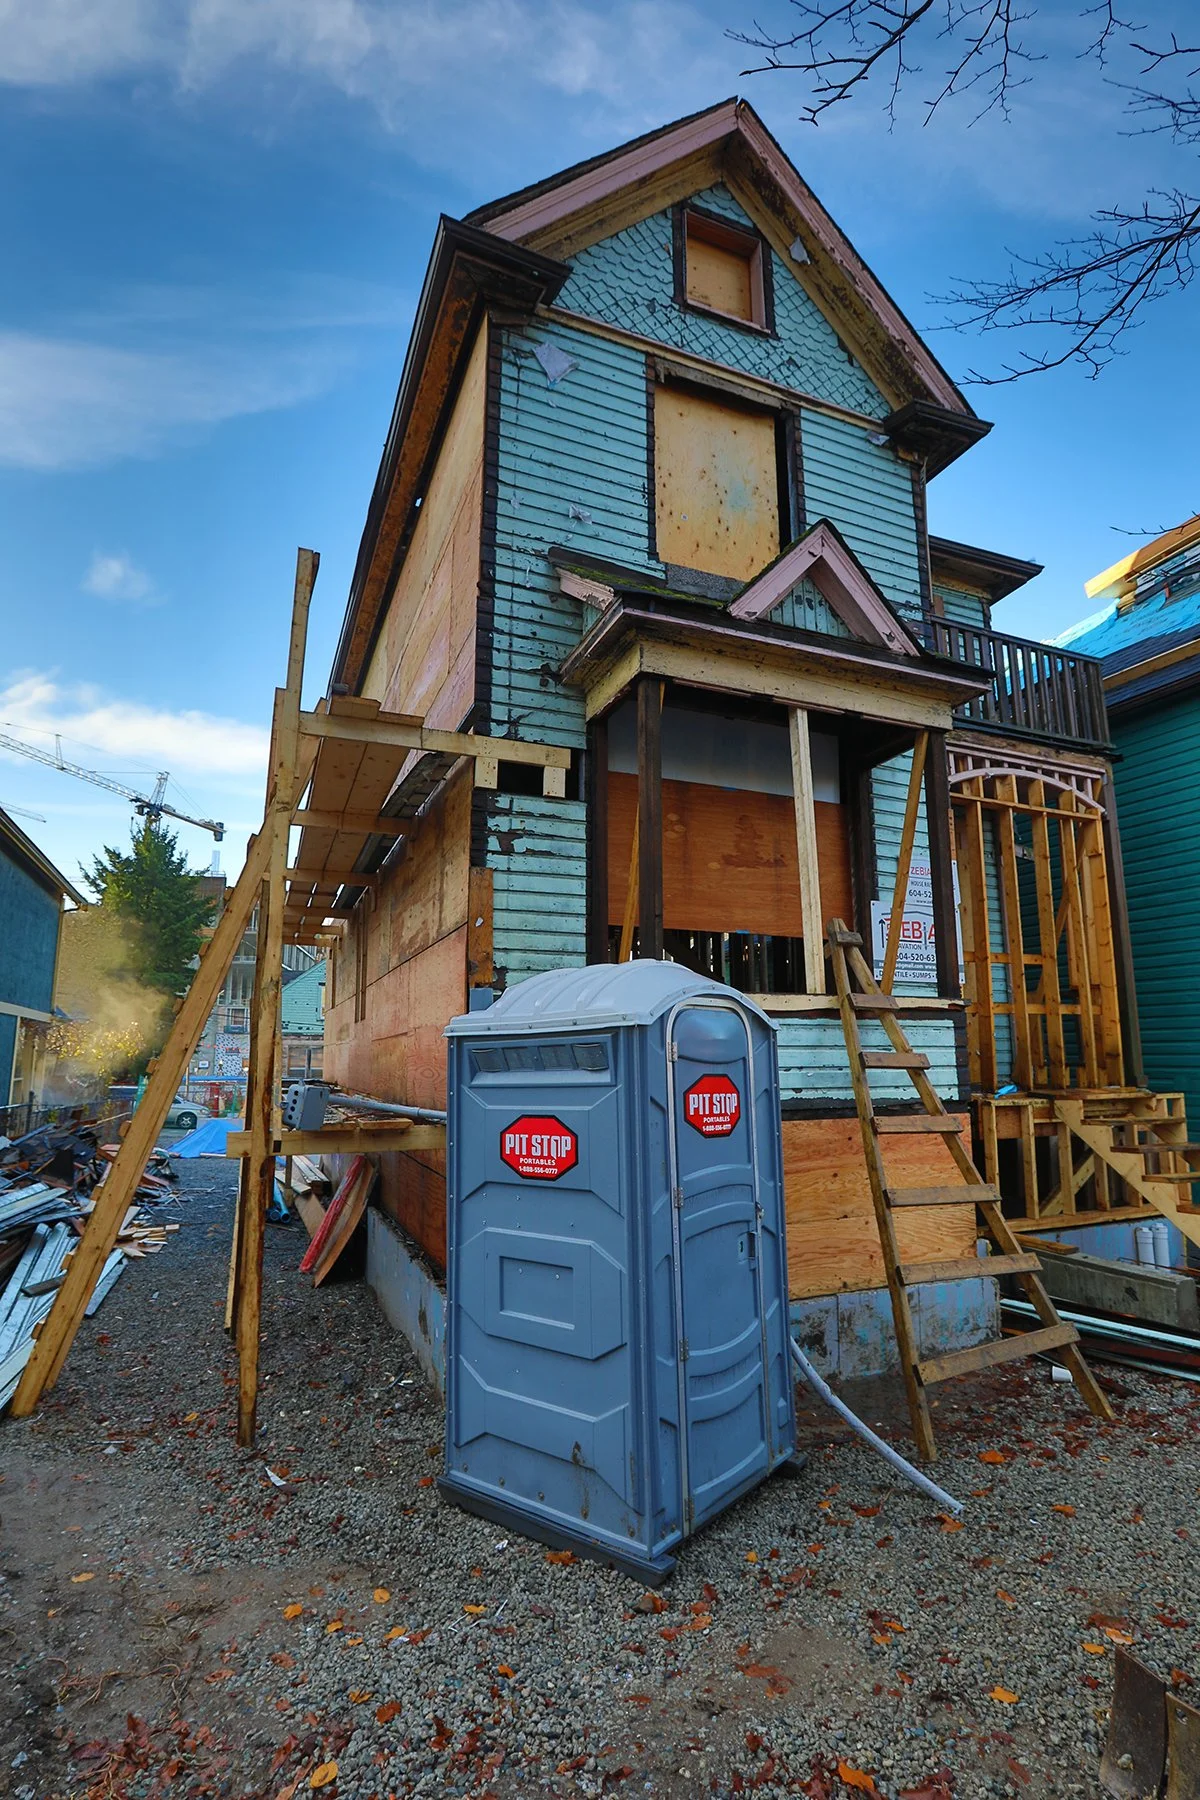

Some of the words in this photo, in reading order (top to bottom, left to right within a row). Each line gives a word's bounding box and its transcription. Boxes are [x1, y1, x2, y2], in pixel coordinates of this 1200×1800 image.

[896, 952, 936, 962] 04-520-63
[689, 1094, 710, 1116] PIT
[712, 1093, 738, 1116] STOP
[505, 1134, 528, 1155] PIT
[532, 1134, 572, 1160] STOP
[520, 1158, 556, 1166] PORTABLES
